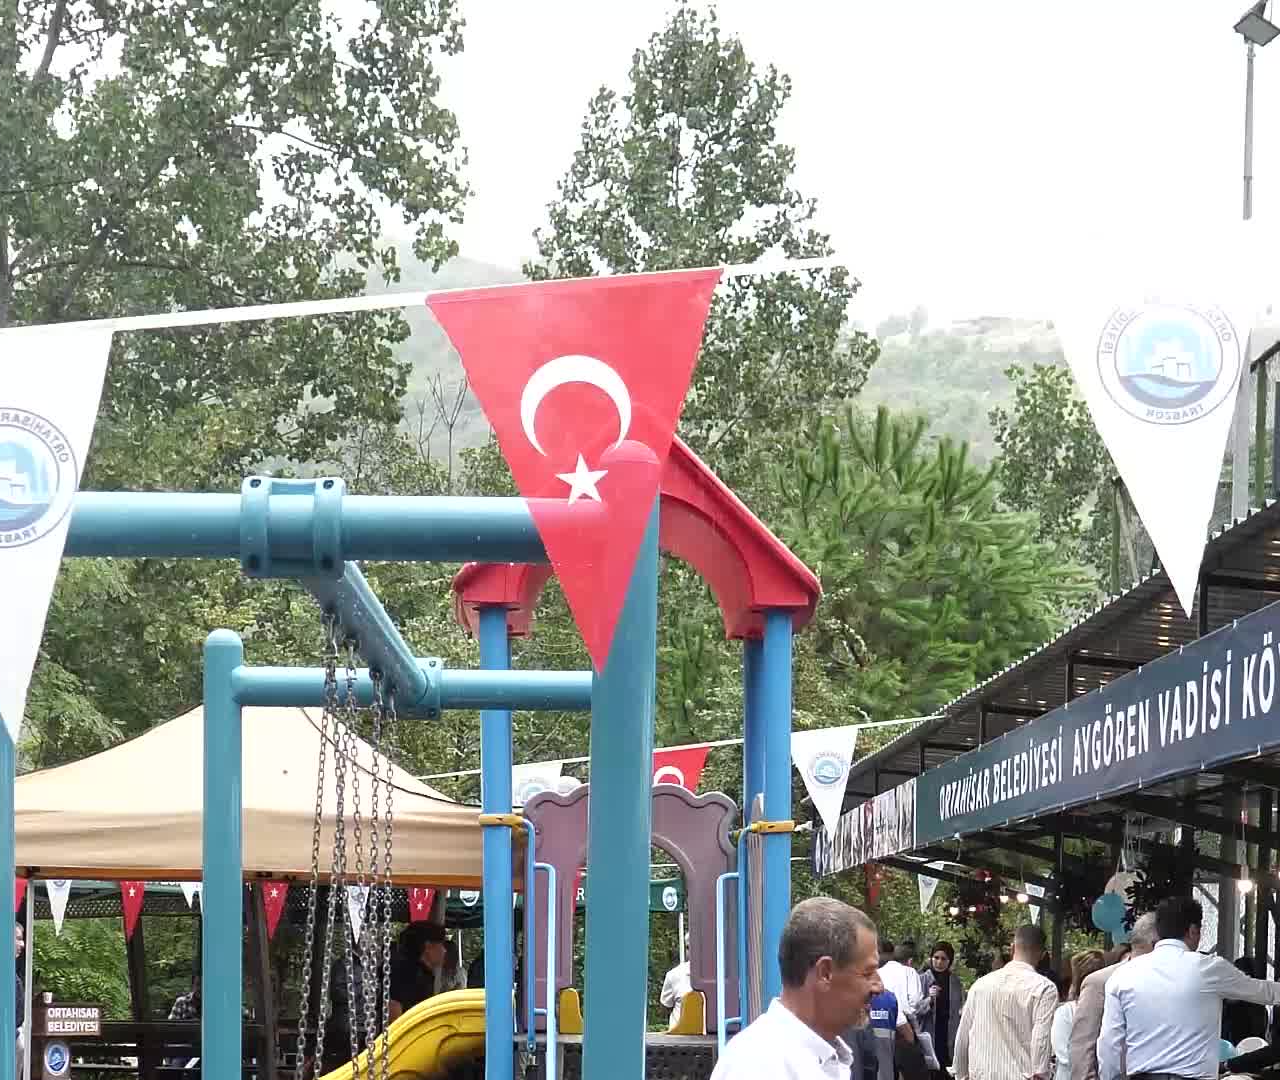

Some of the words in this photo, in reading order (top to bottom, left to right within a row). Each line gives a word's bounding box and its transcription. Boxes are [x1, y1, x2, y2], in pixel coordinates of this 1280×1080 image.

[939, 767, 990, 821] ORTAHİSAR
[992, 725, 1063, 804] BELEDİYESİ
[1072, 700, 1150, 777] AYGÖREN
[1158, 649, 1232, 748] VADİSİ
